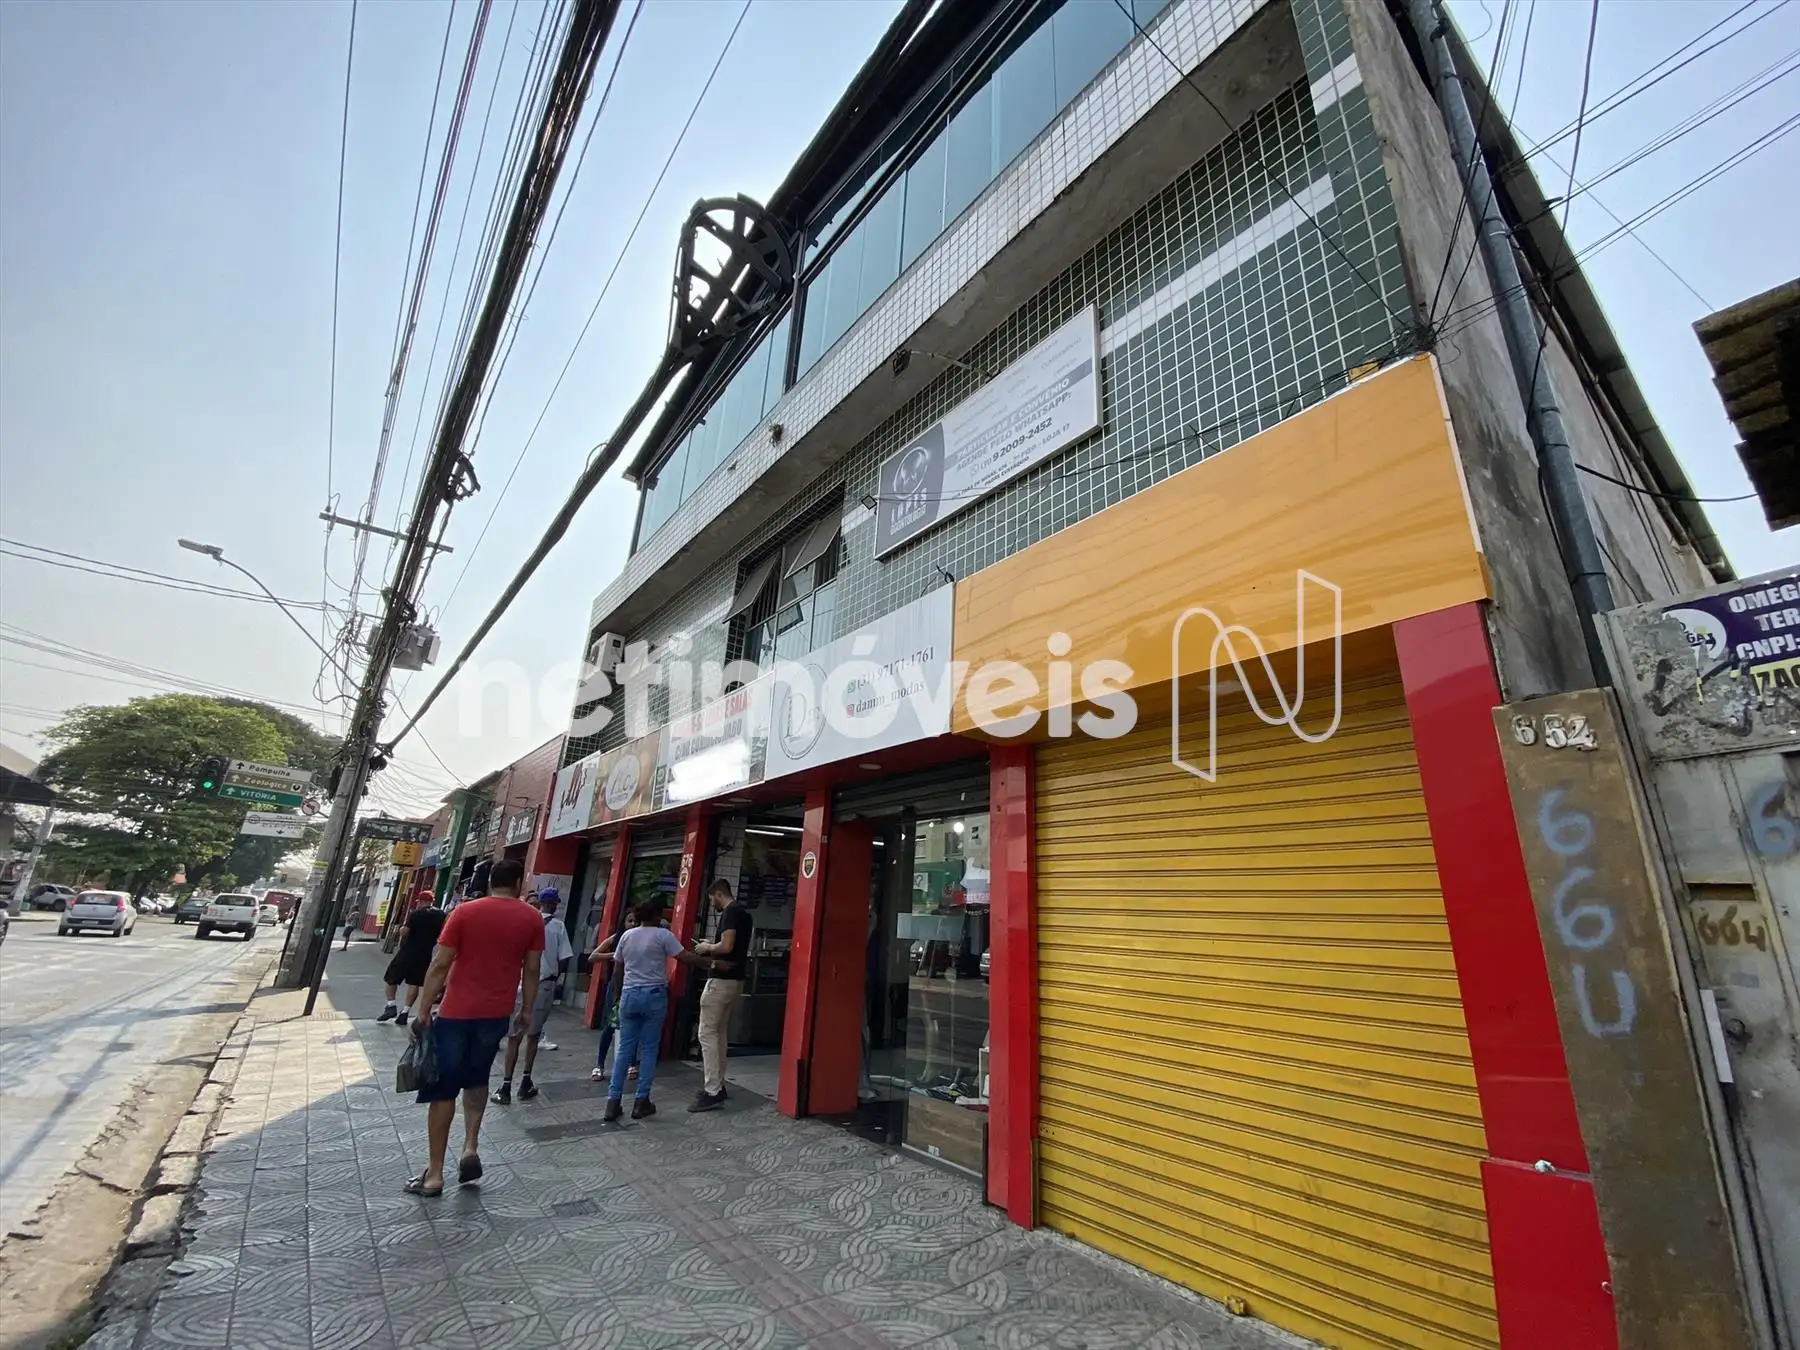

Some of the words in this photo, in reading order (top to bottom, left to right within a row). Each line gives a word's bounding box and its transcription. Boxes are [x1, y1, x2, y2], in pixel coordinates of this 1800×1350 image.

[990, 428, 1012, 450] PELO
[1015, 388, 1071, 433] WHATSAPP:
[1729, 582, 1800, 613] OMEG
[249, 764, 290, 777] Pampulha
[1698, 904, 1766, 952] 664
